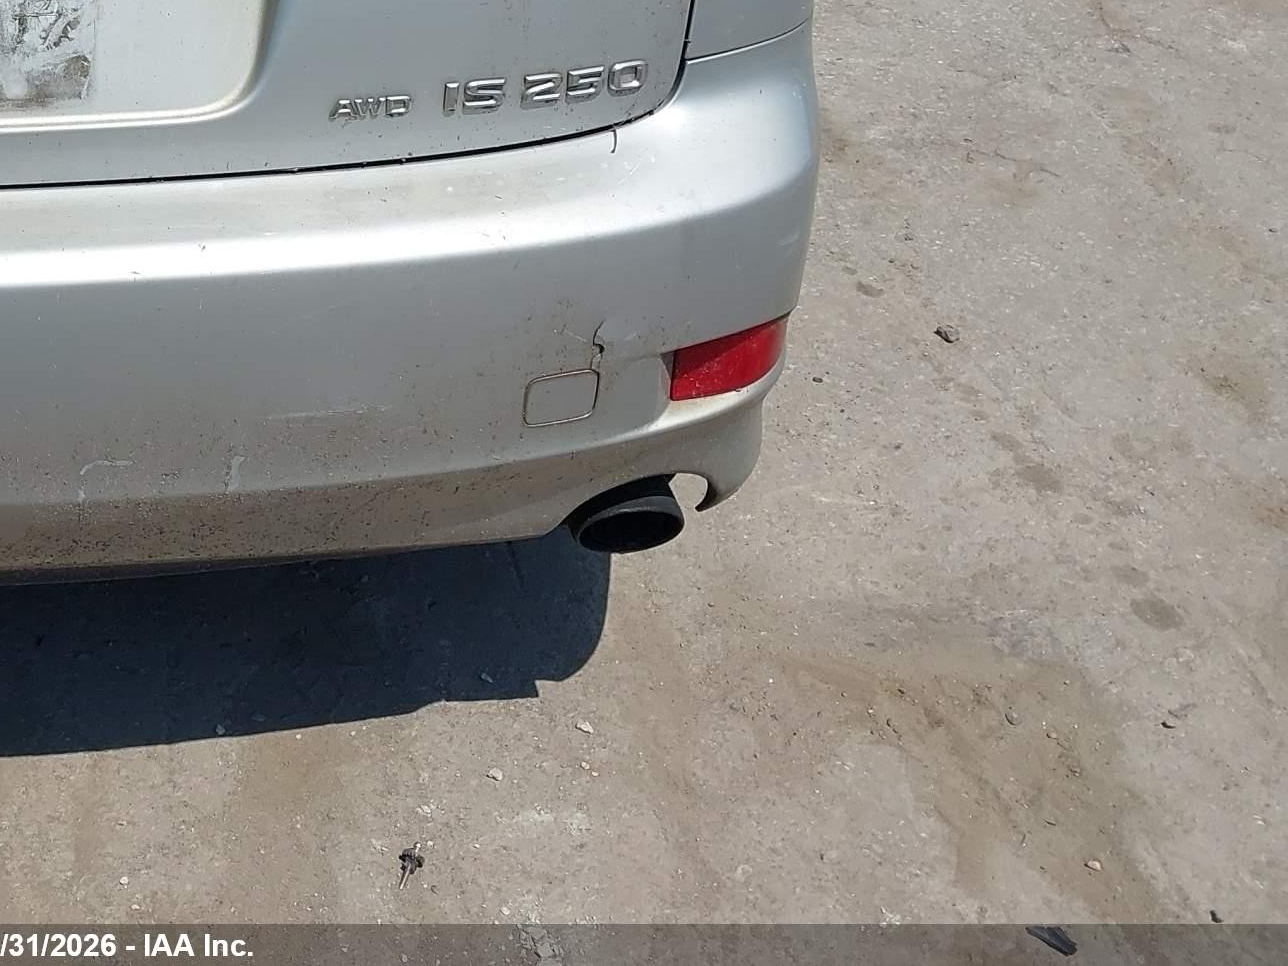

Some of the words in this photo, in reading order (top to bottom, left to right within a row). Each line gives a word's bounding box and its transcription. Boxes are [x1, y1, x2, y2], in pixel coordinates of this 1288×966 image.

[329, 95, 412, 120] AWD
[443, 77, 506, 116] IS
[521, 59, 649, 110] 250
